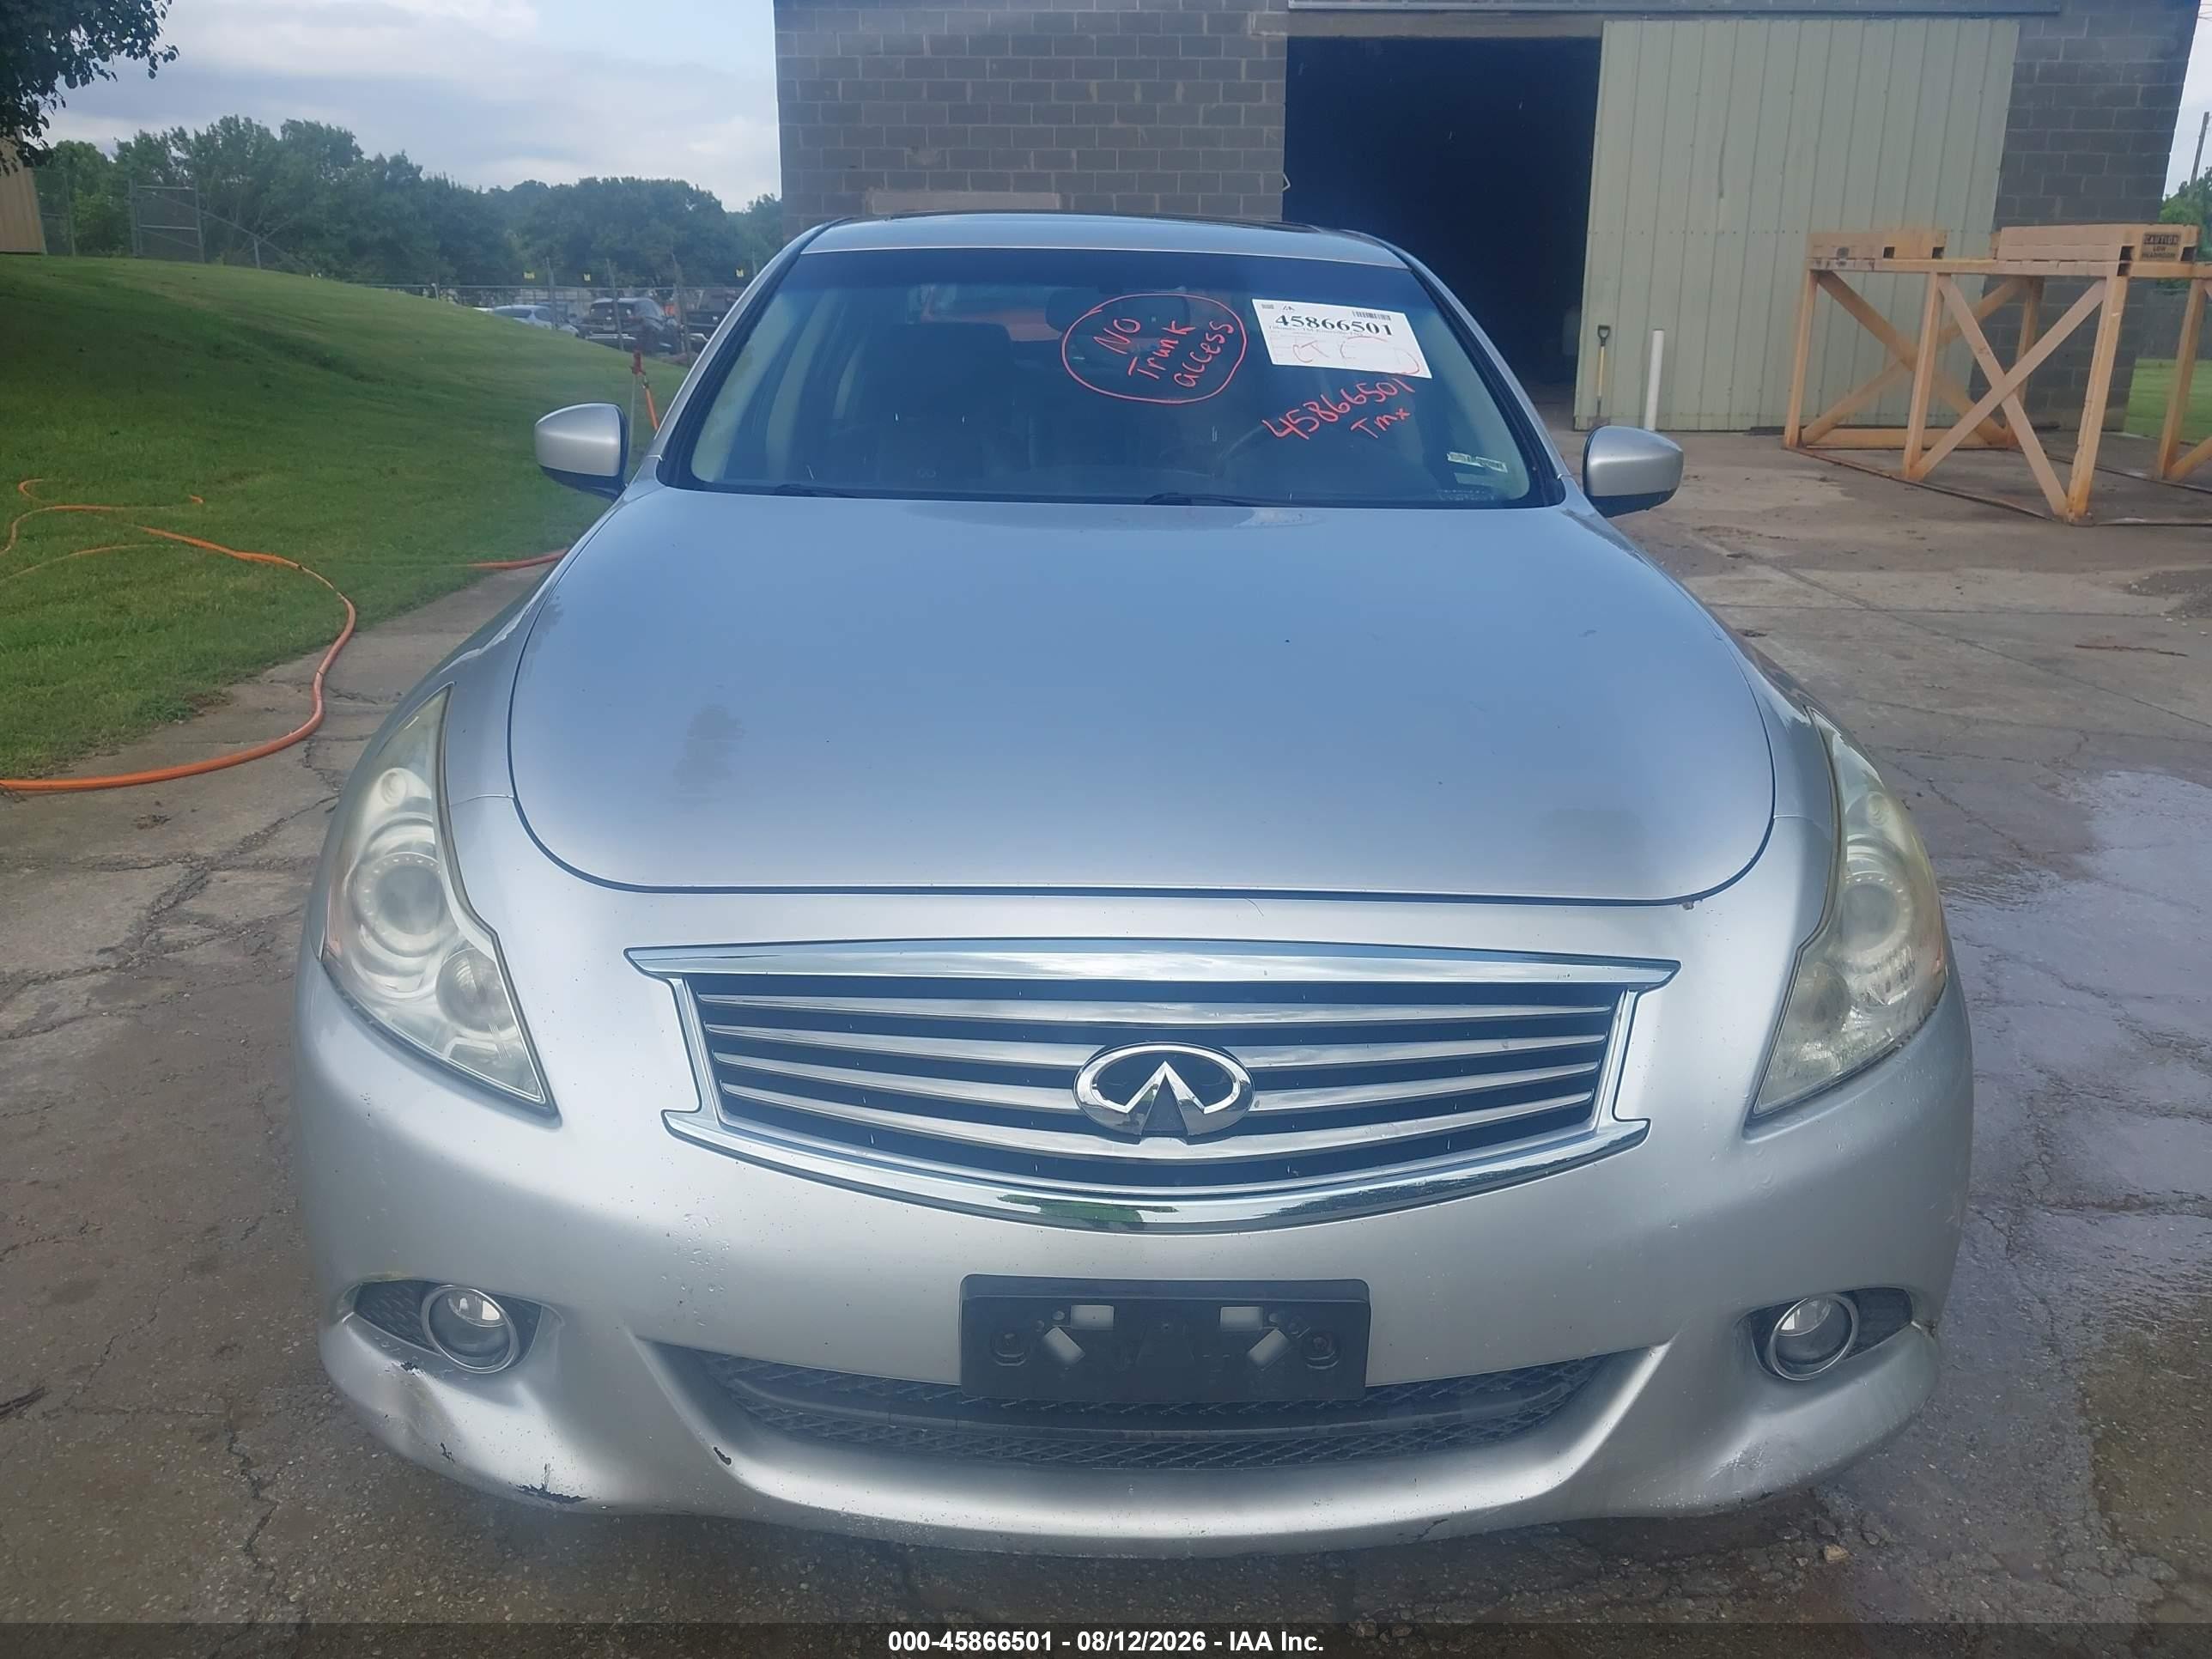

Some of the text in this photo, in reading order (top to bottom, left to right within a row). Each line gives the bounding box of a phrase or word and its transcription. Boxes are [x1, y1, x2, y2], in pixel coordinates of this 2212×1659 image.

[2144, 234, 2179, 244] CAUTION
[1275, 314, 1394, 336] 45866501
[1262, 378, 1415, 440] 45866501
